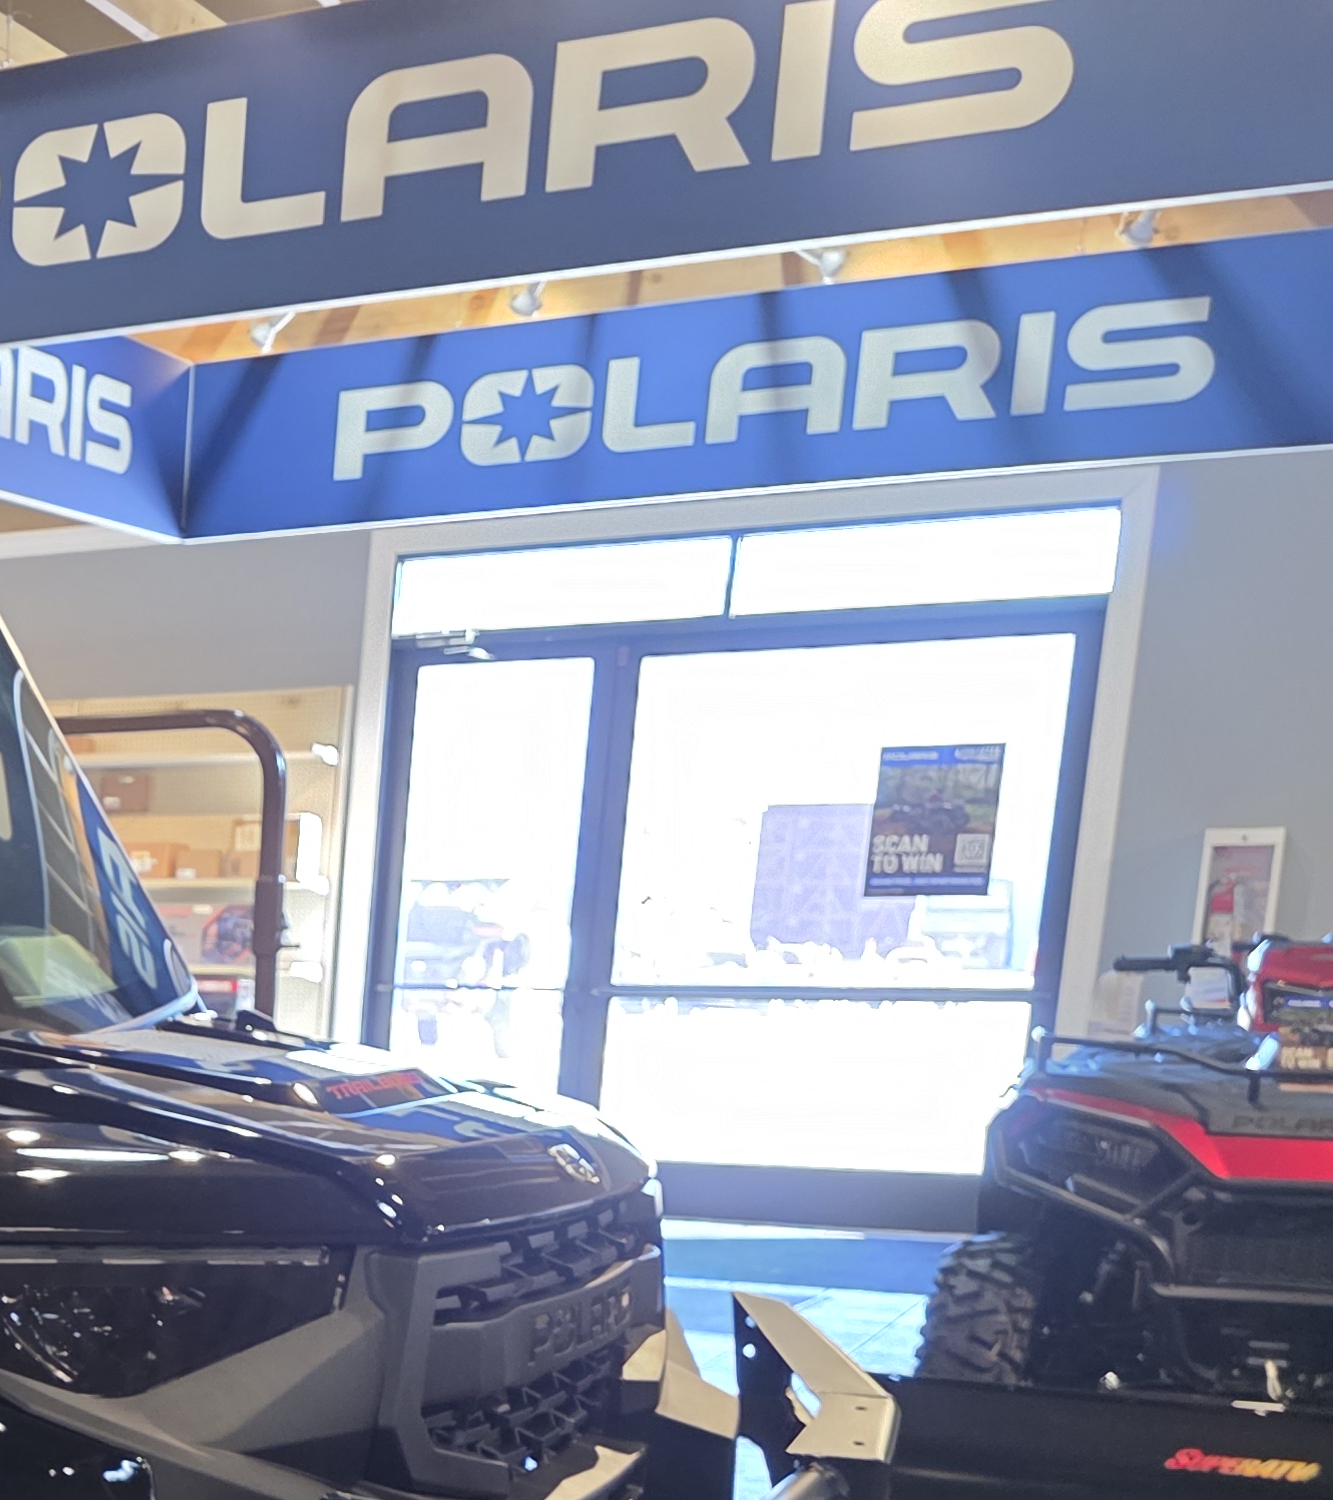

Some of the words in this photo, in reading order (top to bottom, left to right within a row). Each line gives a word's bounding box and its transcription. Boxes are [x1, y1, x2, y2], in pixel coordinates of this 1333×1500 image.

[333, 296, 1215, 481] POLARIS
[872, 833, 930, 855] SCAN
[870, 854, 900, 874] TO
[901, 853, 943, 873] WIN
